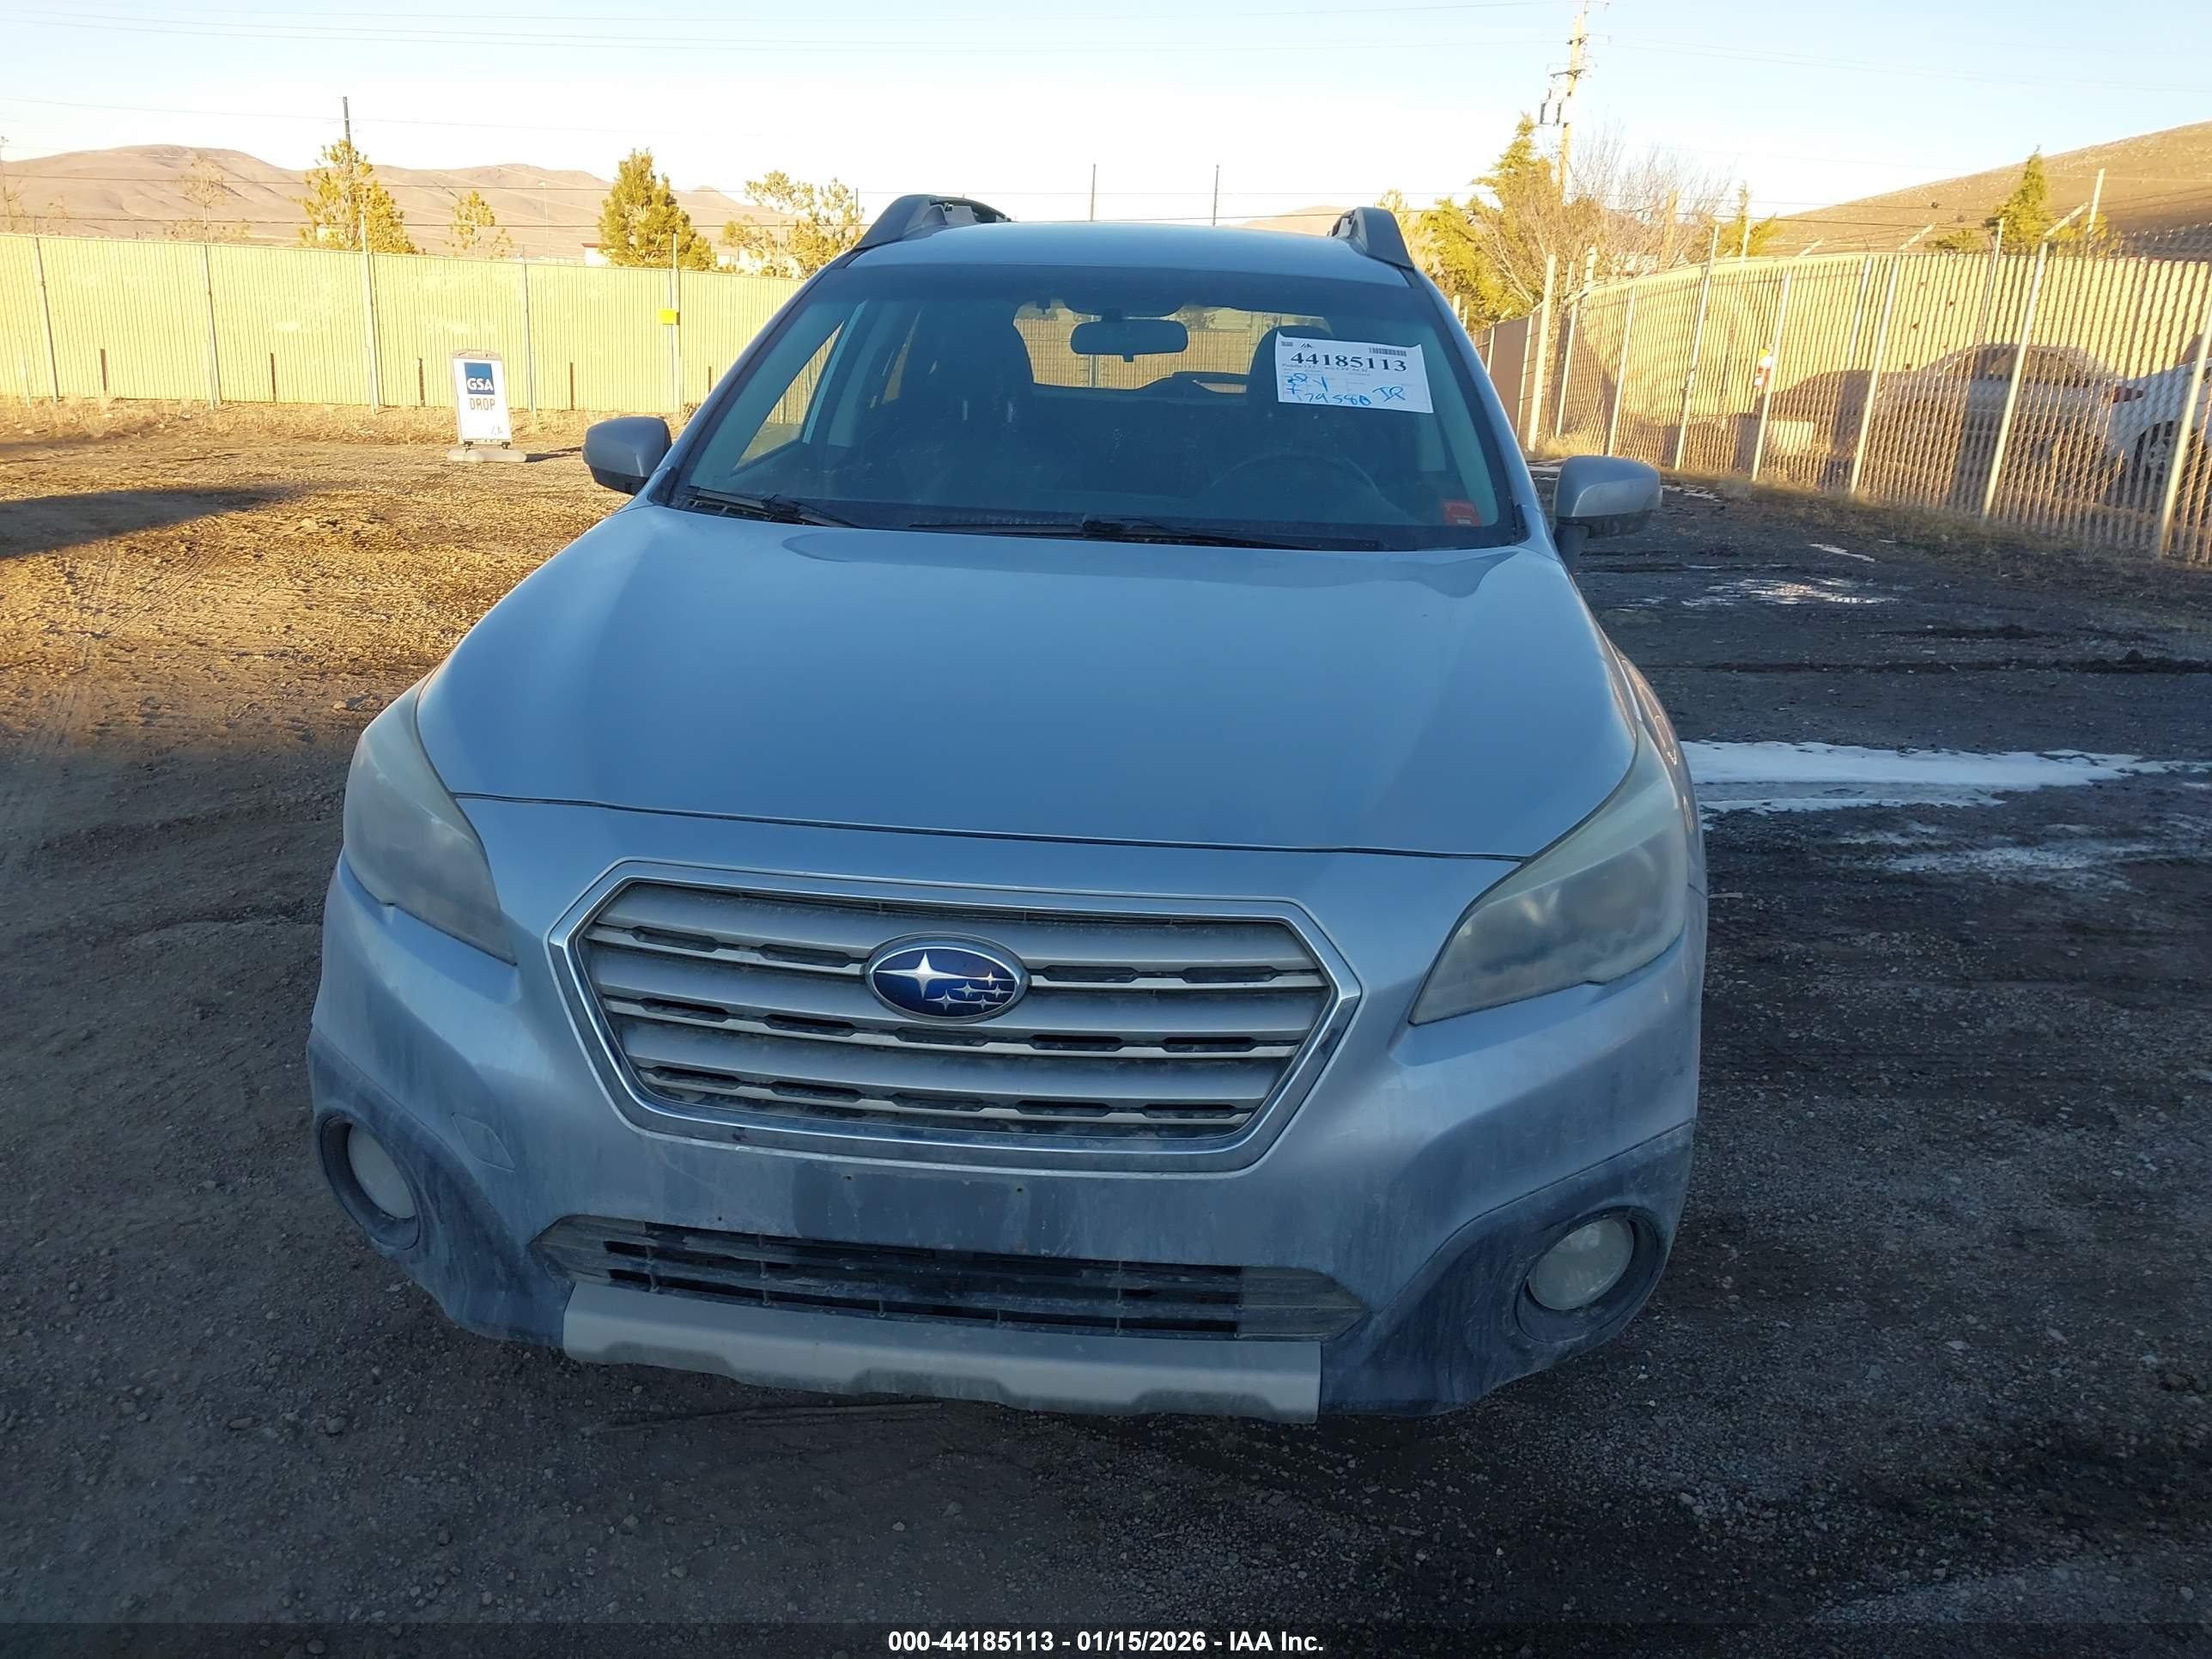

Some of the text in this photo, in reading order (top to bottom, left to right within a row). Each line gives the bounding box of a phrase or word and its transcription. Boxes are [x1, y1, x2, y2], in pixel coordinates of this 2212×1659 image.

[1291, 352, 1407, 372] 44185113
[466, 377, 494, 391] GSA
[469, 398, 495, 410] DROP
